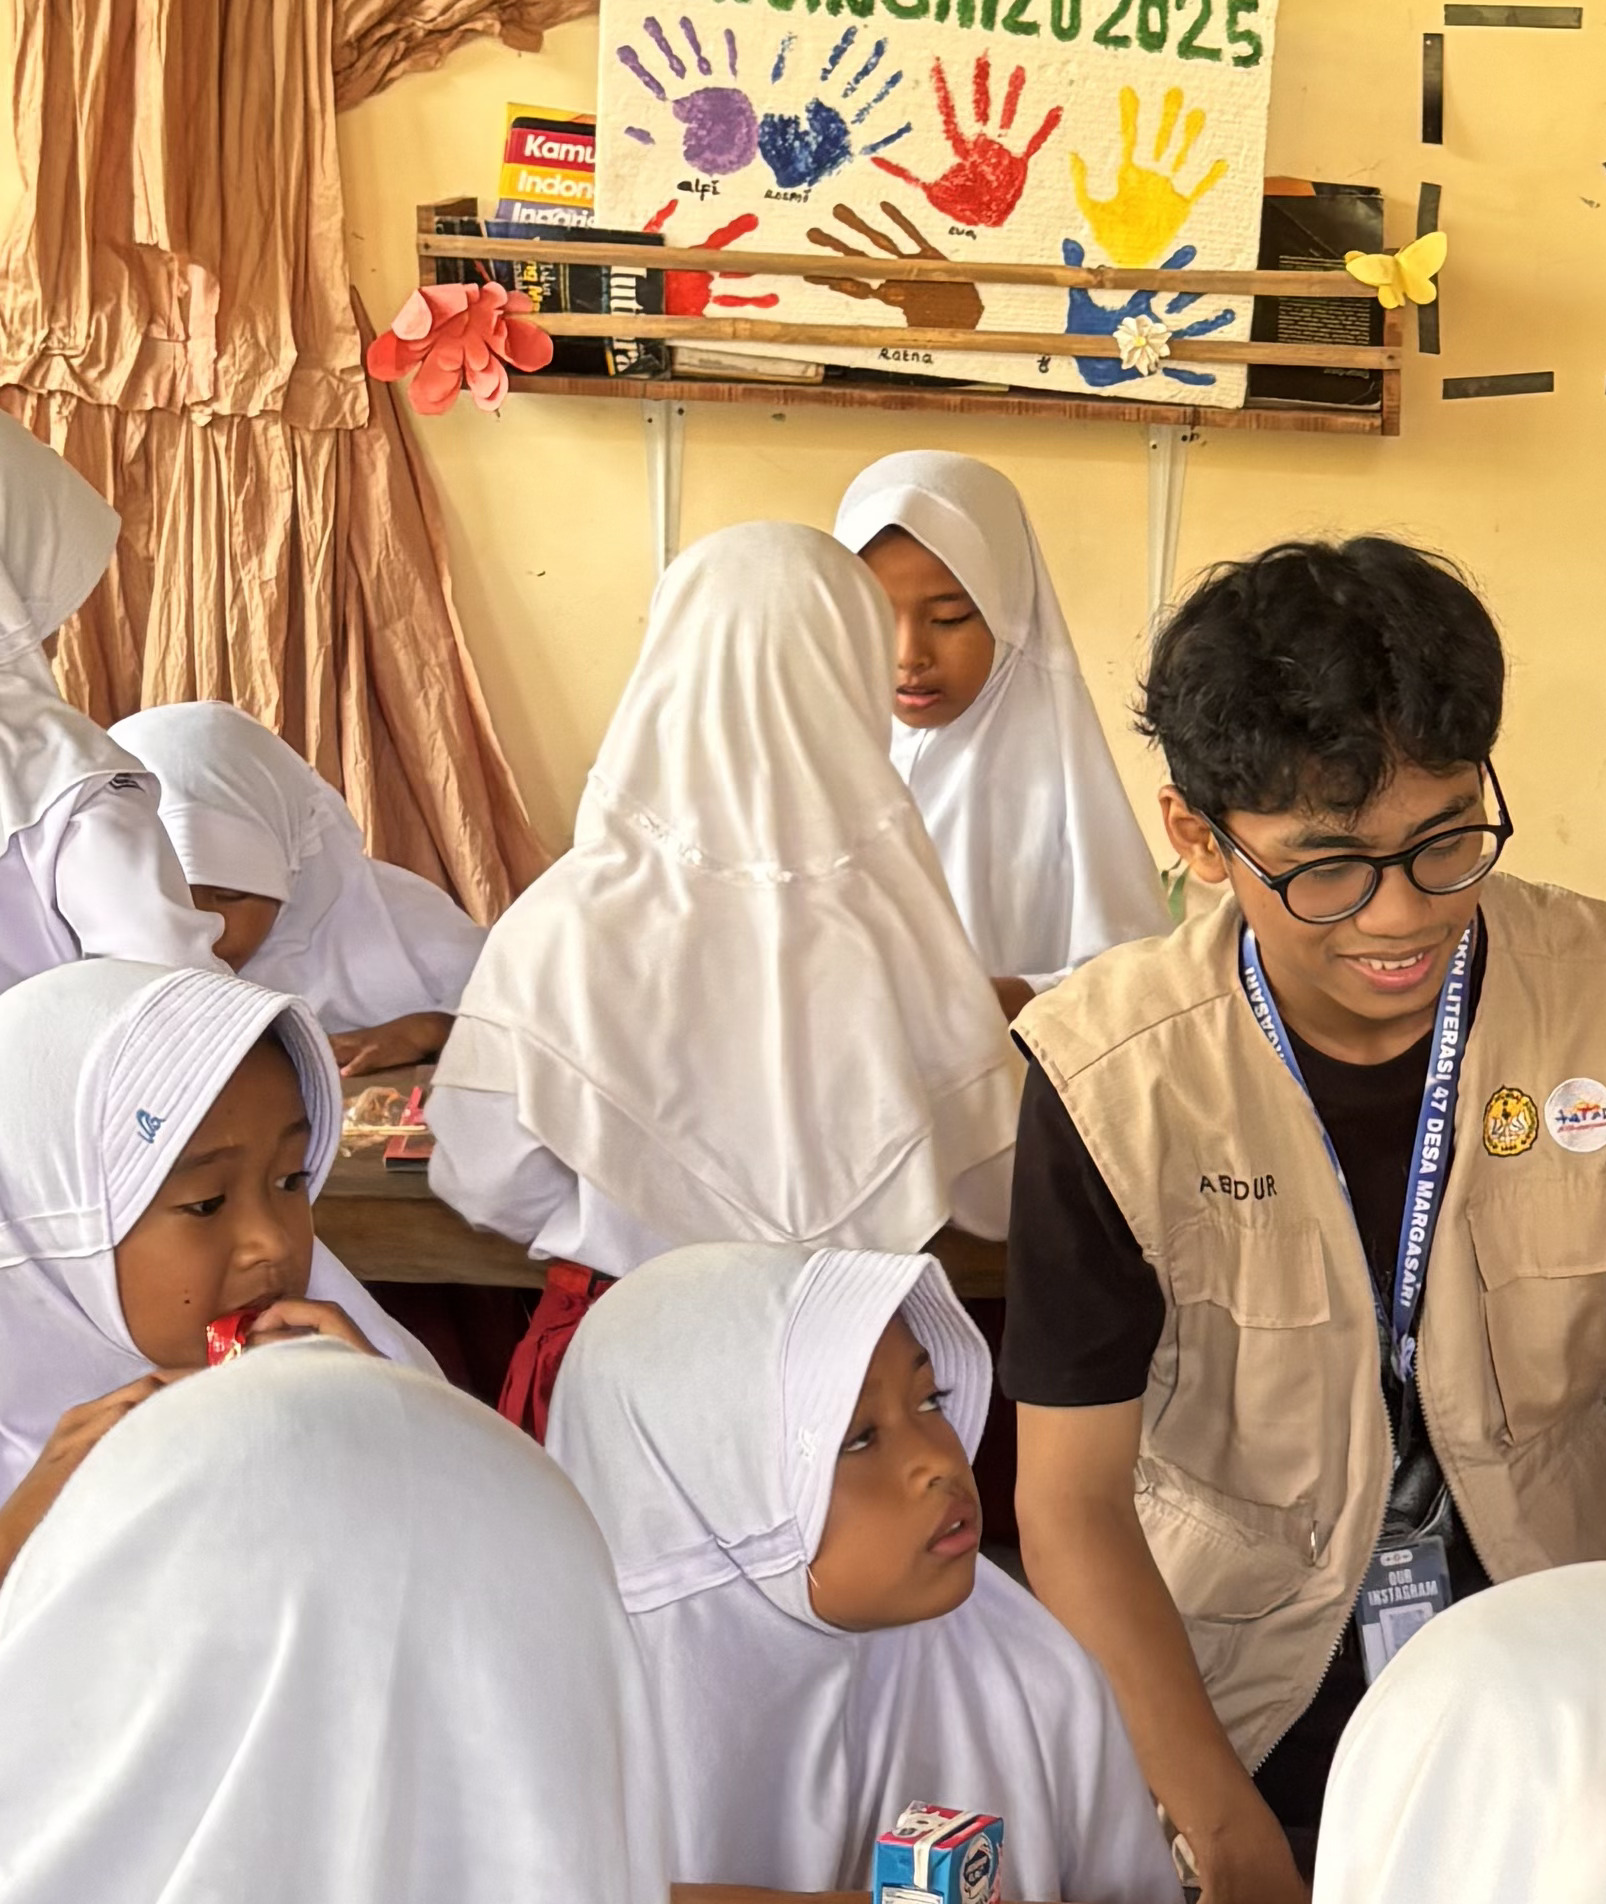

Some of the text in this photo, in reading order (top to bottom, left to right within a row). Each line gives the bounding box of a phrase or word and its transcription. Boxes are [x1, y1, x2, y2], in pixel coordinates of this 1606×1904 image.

[517, 169, 596, 197] Indon
[1436, 981, 1462, 1082] LITERASI
[1431, 1086, 1450, 1114] 47
[1420, 1117, 1443, 1173] DESA
[1200, 1175, 1277, 1200] ABDUR
[1400, 1178, 1437, 1308] MARGASARI
[1389, 1569, 1412, 1586] OUR
[1367, 1580, 1438, 1606] INSTAGRAM
